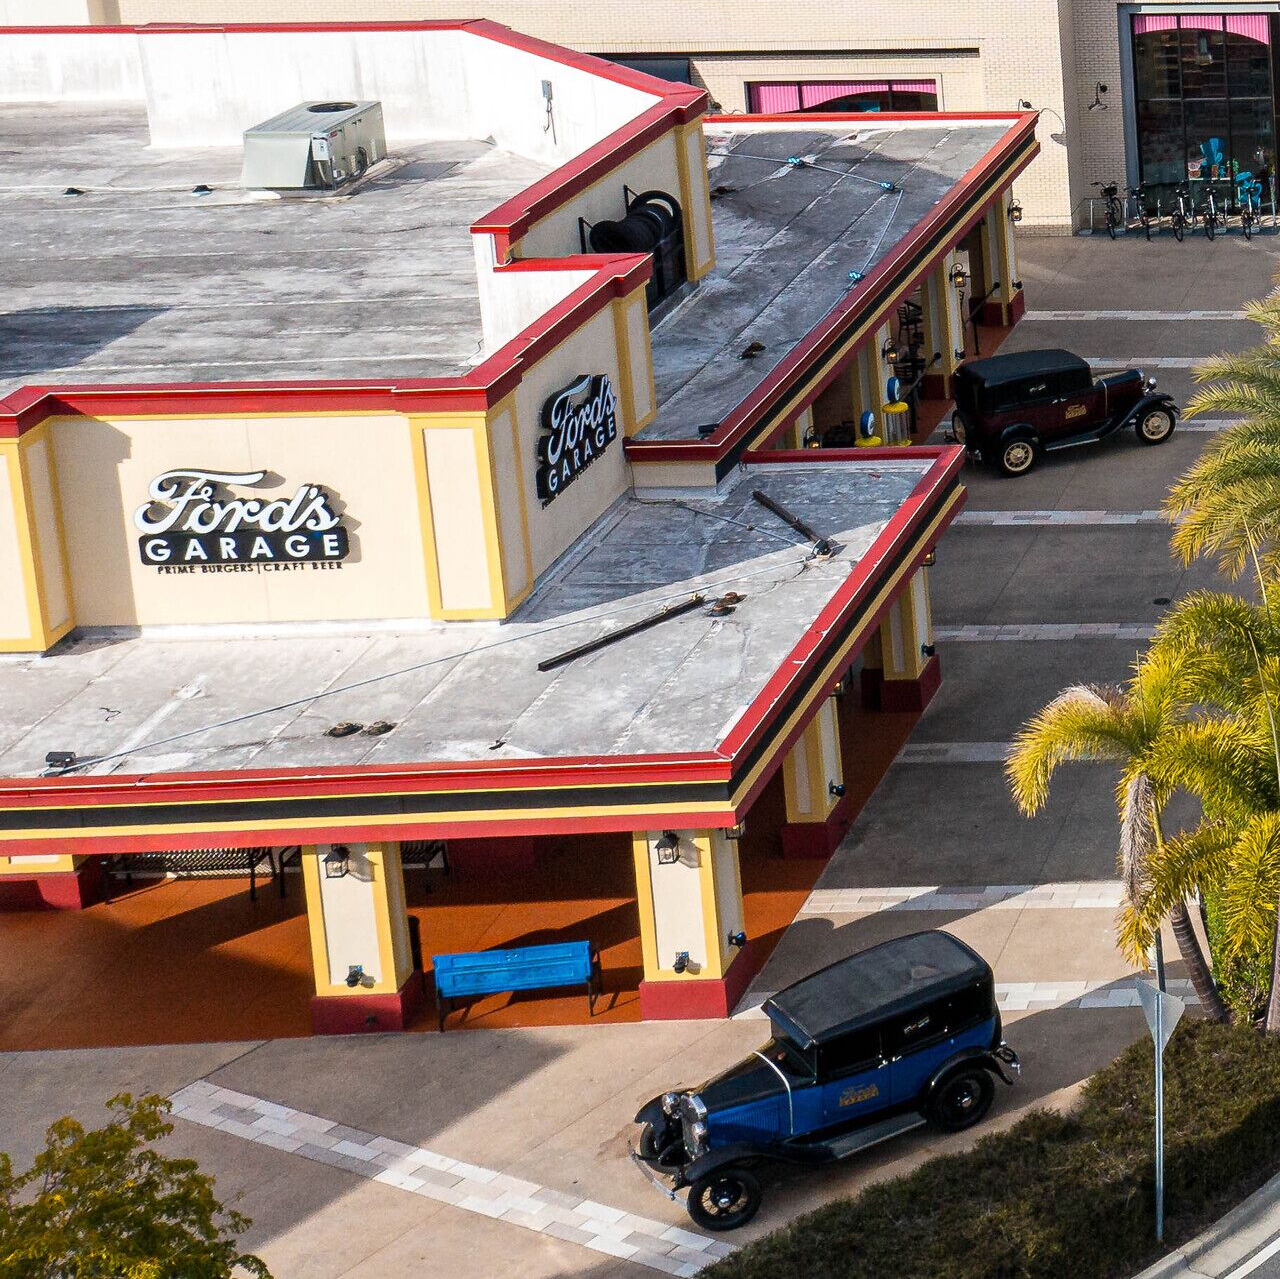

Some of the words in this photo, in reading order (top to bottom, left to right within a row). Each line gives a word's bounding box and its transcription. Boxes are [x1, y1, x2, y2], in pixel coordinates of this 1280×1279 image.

[547, 375, 617, 466] Ford's
[548, 416, 614, 492] GARAGE
[133, 469, 341, 535] Ford's
[144, 534, 341, 562] GARAGE
[157, 565, 195, 575] PRIME
[201, 563, 254, 574] BURGERS
[263, 562, 305, 572] CRAFT
[312, 561, 343, 570] BEER
